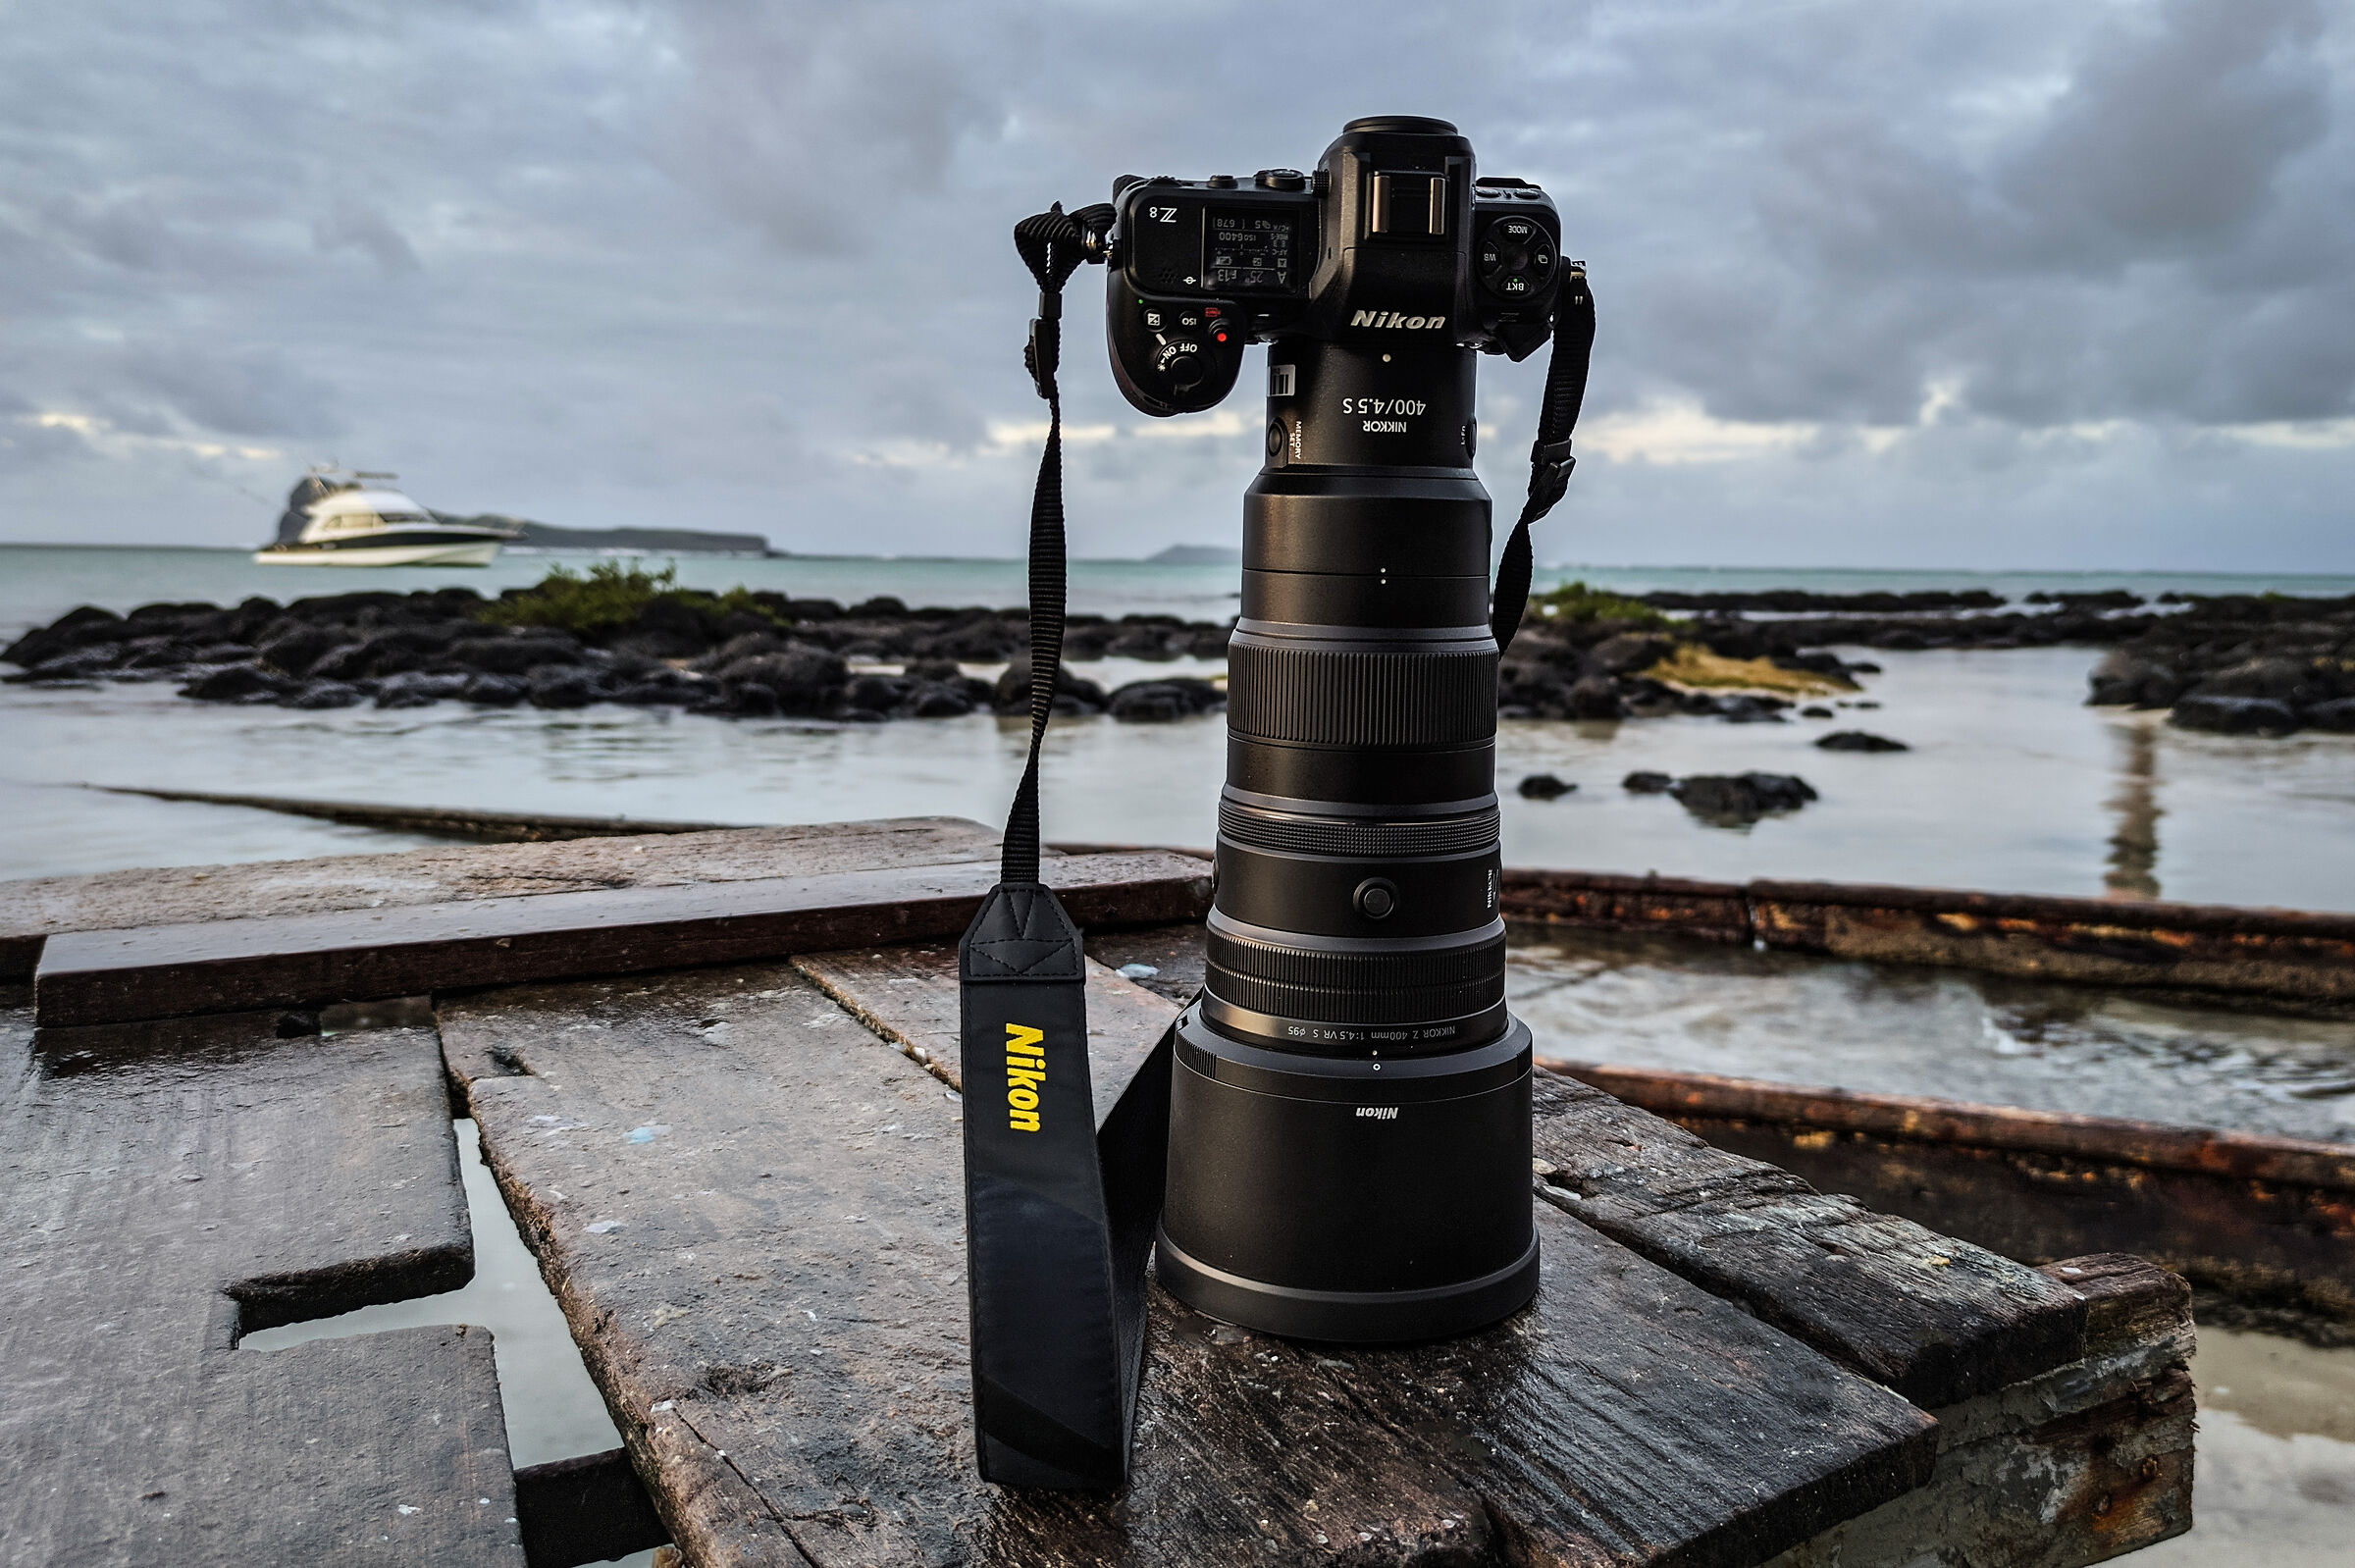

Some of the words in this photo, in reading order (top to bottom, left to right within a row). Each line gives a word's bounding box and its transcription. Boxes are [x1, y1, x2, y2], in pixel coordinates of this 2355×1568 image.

[1508, 225, 1528, 235] MODE
[1484, 253, 1496, 262] WB
[1506, 282, 1525, 291] BKT
[1181, 317, 1197, 326] ISO
[1350, 309, 1446, 330] Nikon
[1162, 345, 1178, 360] ON
[1179, 342, 1198, 353] OFF
[1342, 397, 1353, 414] S
[1357, 397, 1427, 416] 400/4.5
[1362, 420, 1407, 433] NIKKOR
[1294, 420, 1303, 459] MEMORY
[1313, 1028, 1319, 1038] S
[1324, 1029, 1337, 1039] VR
[1371, 1030, 1408, 1040] 400mm
[1413, 1030, 1419, 1039] Z
[1423, 1025, 1455, 1038] NIKKOR
[1005, 1022, 1047, 1132] Nikon
[1355, 1107, 1398, 1120] Nikon
